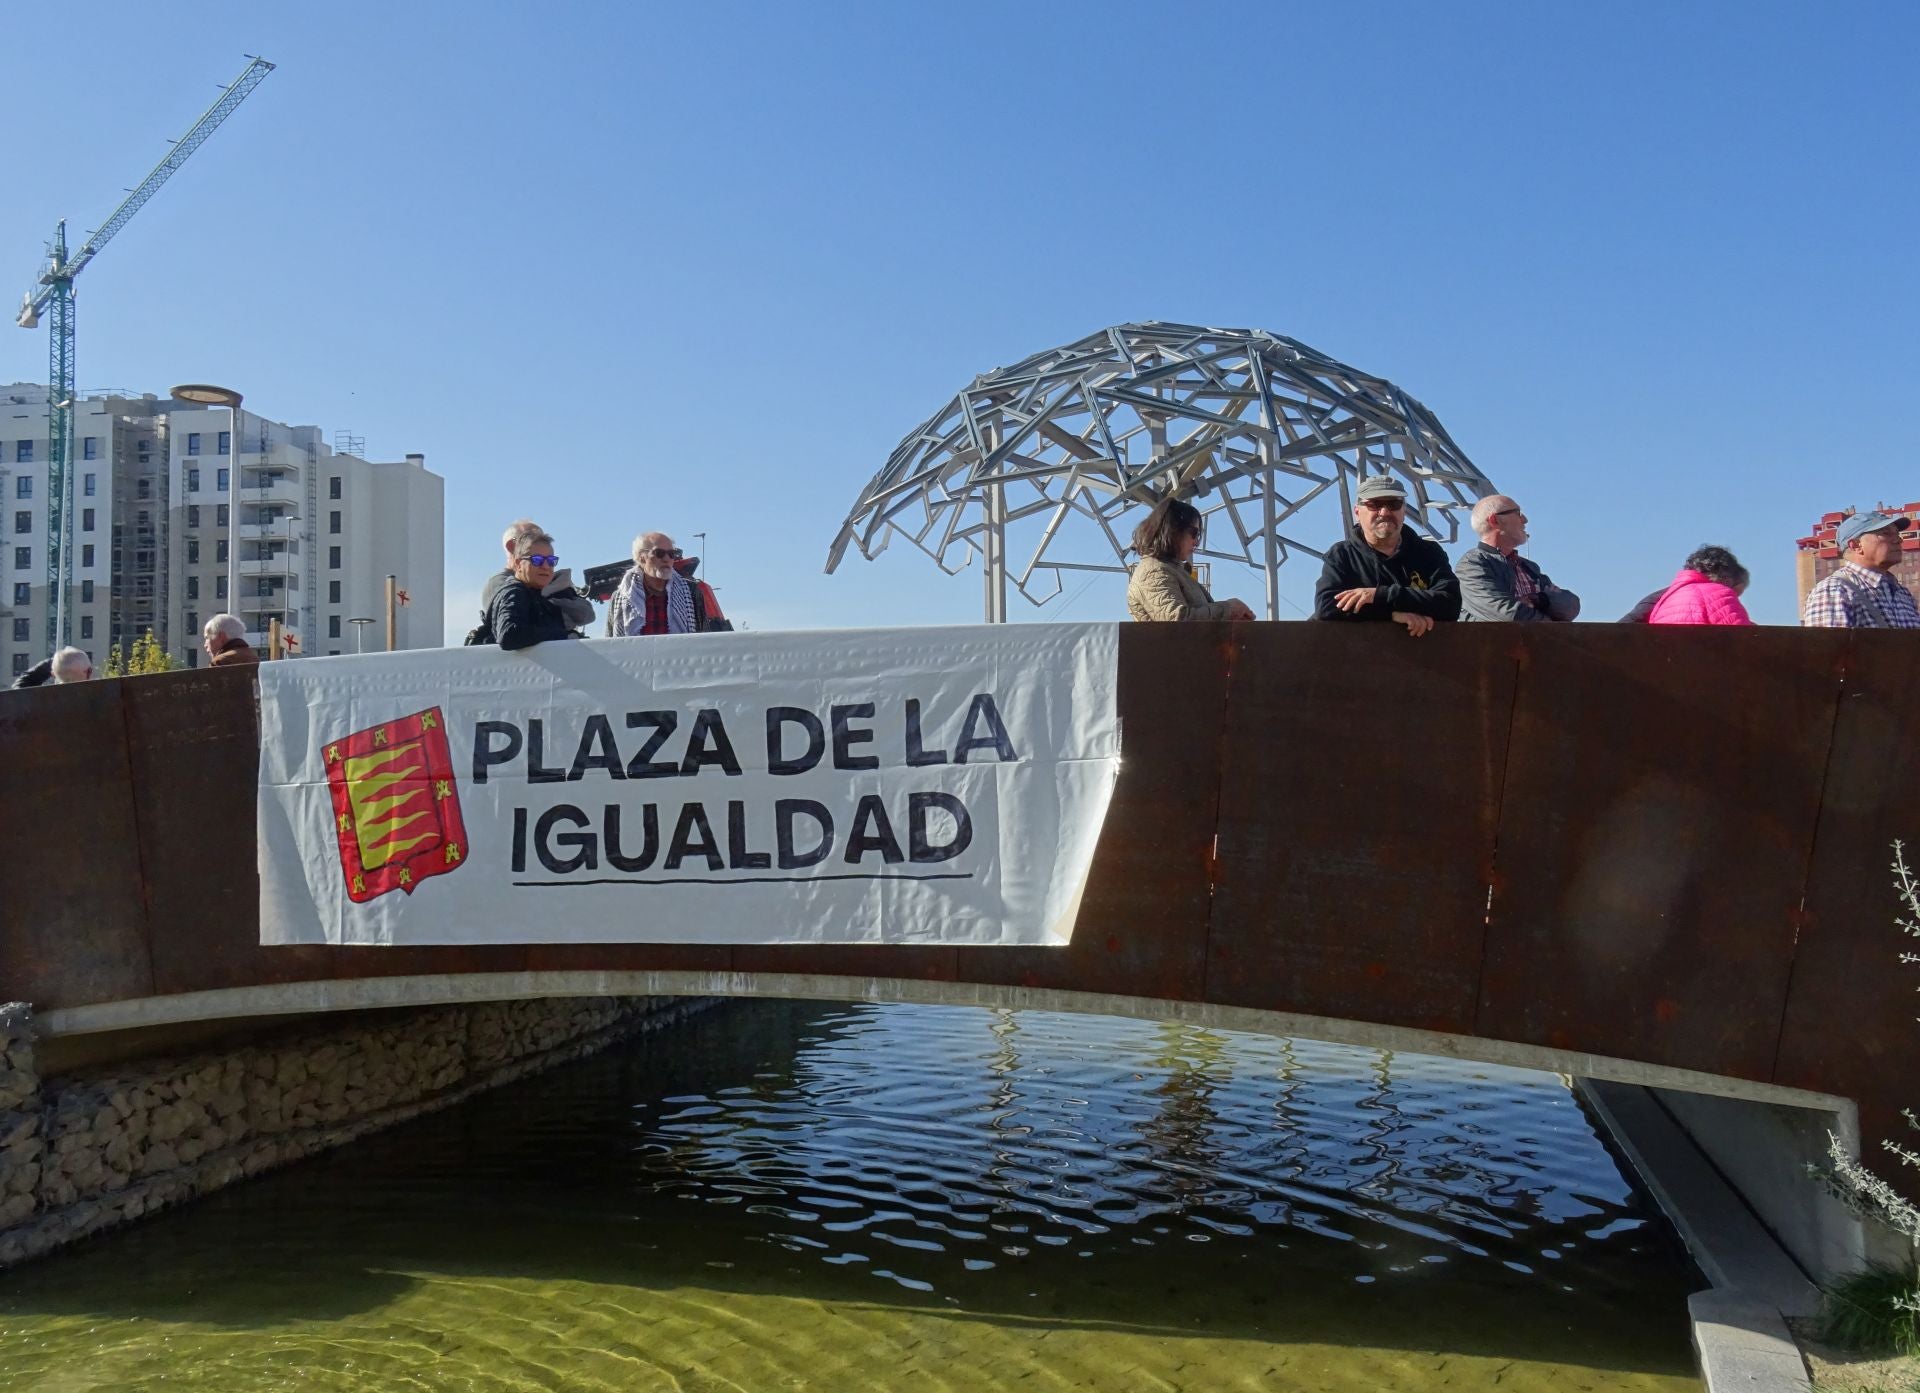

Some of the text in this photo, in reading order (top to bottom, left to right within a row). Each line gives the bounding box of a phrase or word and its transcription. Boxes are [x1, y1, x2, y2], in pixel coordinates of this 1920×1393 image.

[472, 694, 1019, 785] PLAZA DE LA
[511, 791, 974, 873] IGUALDAD
